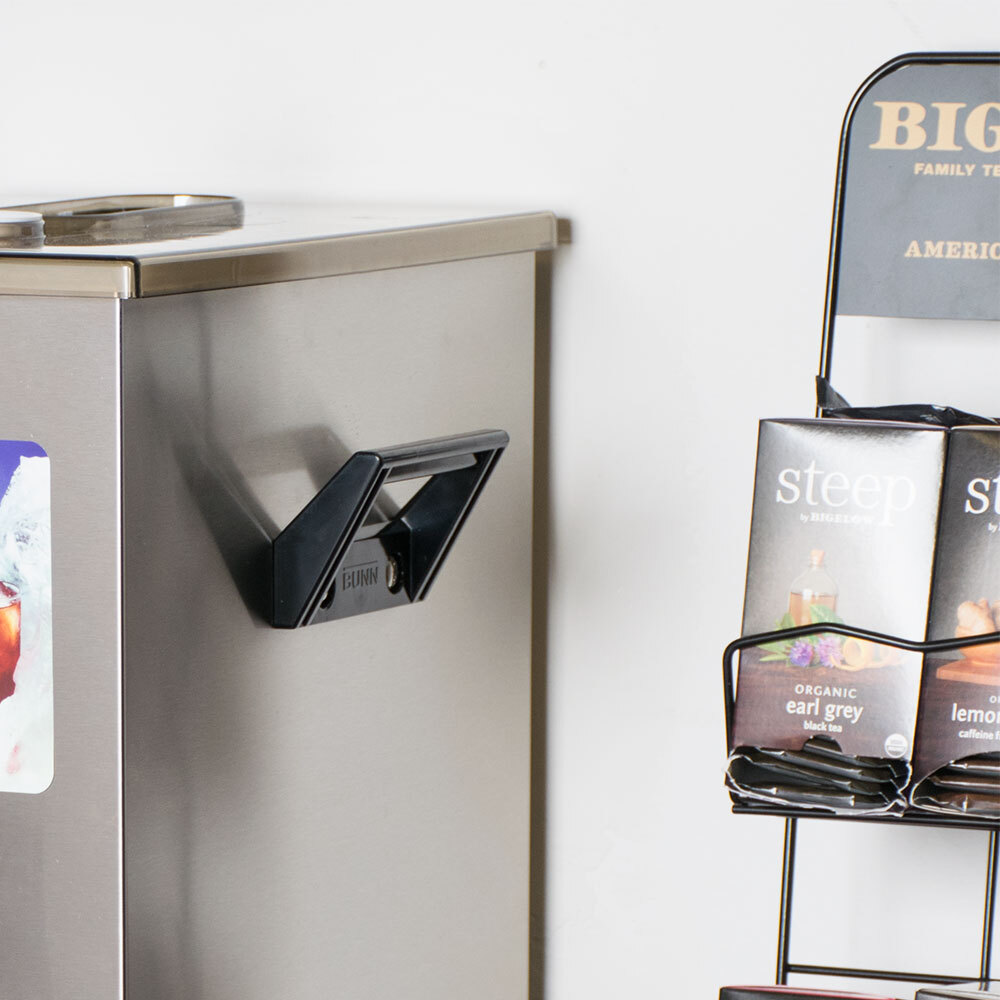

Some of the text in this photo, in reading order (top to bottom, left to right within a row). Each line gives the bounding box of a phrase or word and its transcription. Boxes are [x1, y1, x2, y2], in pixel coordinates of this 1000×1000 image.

[868, 101, 1000, 153] BIG
[913, 162, 977, 176] FAMILY
[775, 459, 917, 528] steep
[799, 513, 810, 523] by
[342, 565, 379, 591] BUNN
[794, 684, 858, 699] ORGANIC
[785, 698, 864, 725] earl grey
[803, 720, 843, 733] black tea
[959, 728, 994, 740] caffeine
